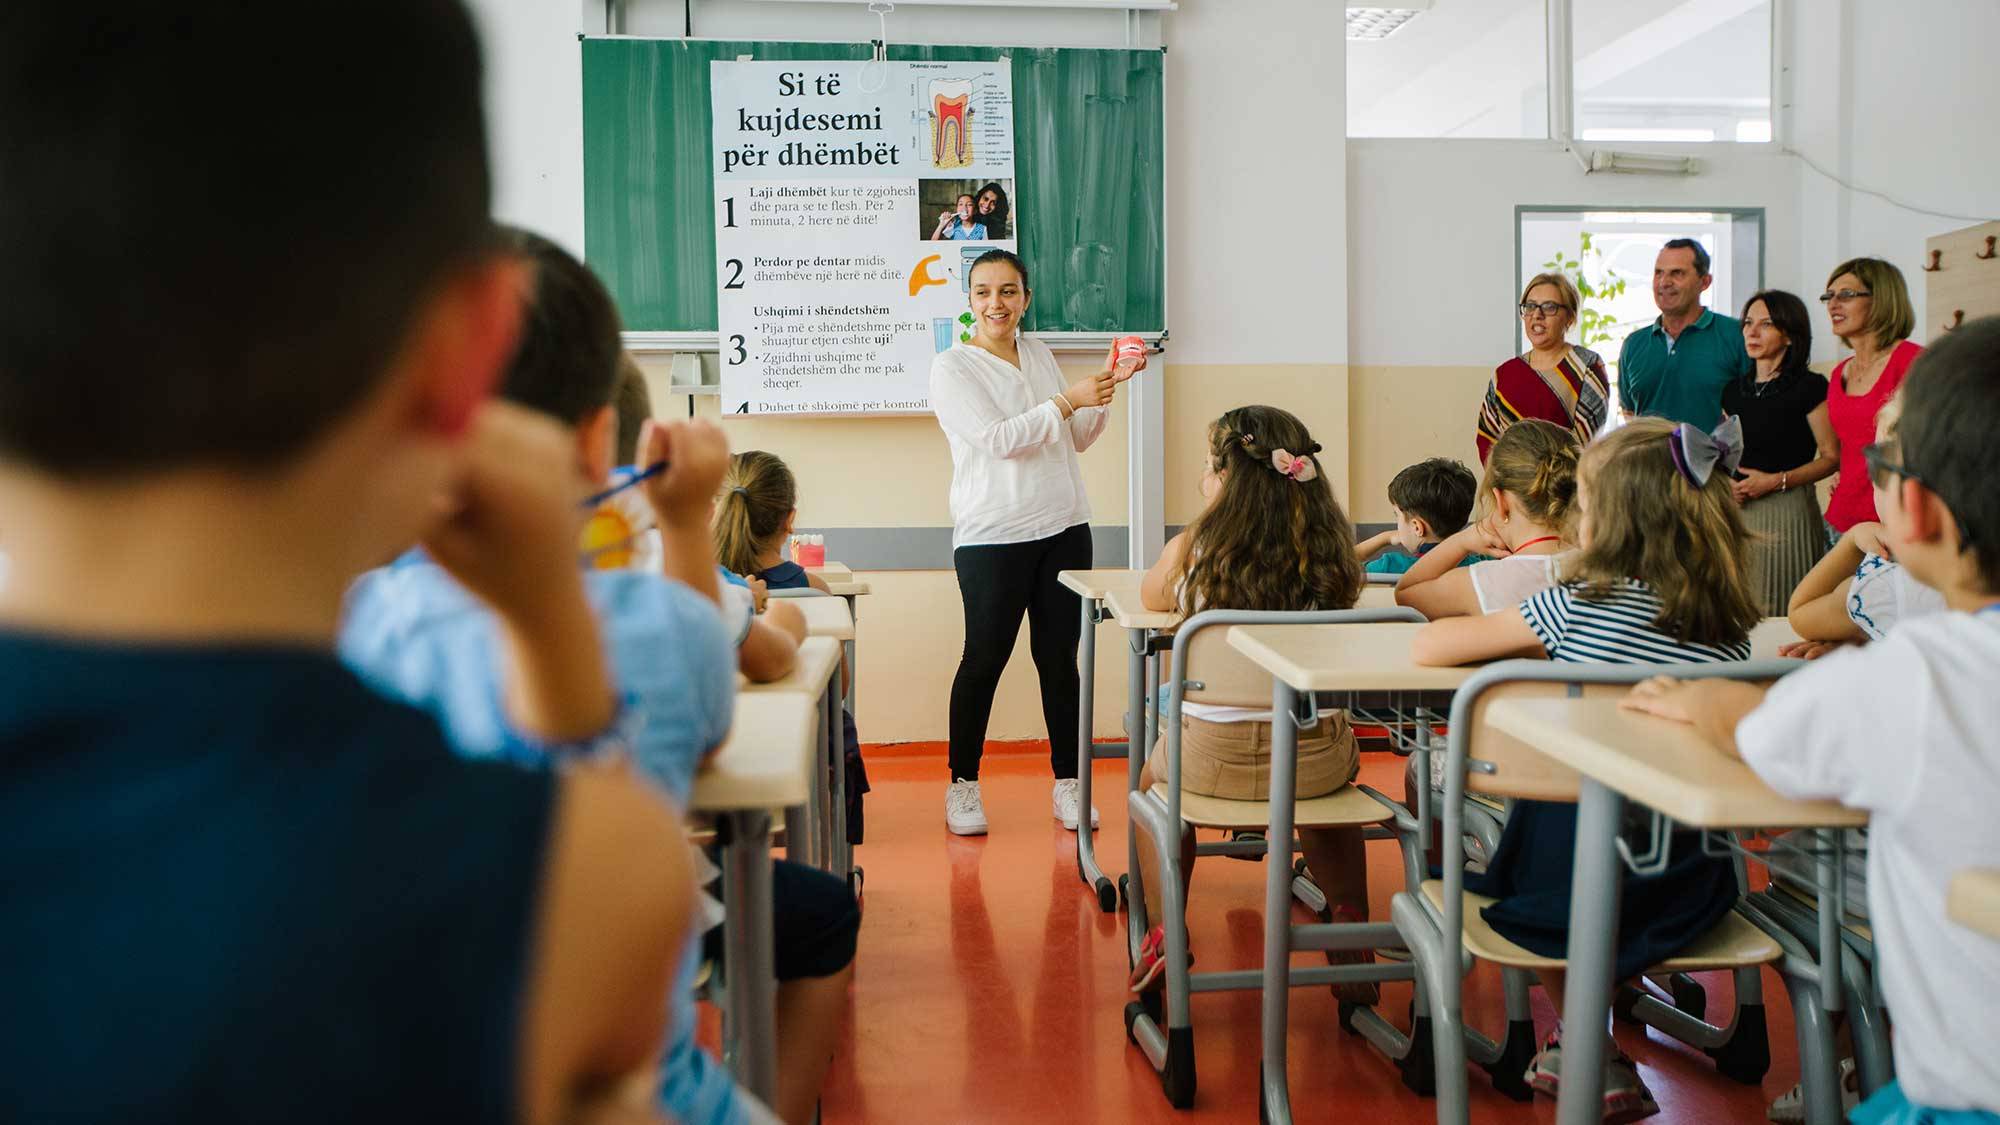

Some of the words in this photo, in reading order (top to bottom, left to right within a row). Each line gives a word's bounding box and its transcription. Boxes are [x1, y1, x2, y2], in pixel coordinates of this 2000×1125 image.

[779, 72, 805, 96] Si
[815, 73, 841, 96] të
[738, 107, 883, 136] kujdesemi
[723, 144, 769, 172] për
[778, 142, 900, 166] dhëmbët
[750, 186, 773, 199] Laji
[777, 185, 827, 198] dhëmbët
[831, 186, 850, 197] kur
[853, 187, 864, 196] të
[866, 185, 917, 199] zgjohesh
[722, 197, 739, 228] 1
[750, 201, 771, 212] dhe
[774, 202, 799, 214] para
[803, 203, 815, 211] se
[831, 200, 861, 211] flesh.
[865, 199, 884, 211] Për
[888, 200, 894, 210] 2
[751, 215, 795, 228] minuta,
[798, 215, 805, 226] 2
[836, 216, 850, 225] në
[853, 215, 878, 225] ditë!
[754, 256, 793, 267] Perdor
[797, 258, 810, 269] pe
[813, 255, 851, 266] dentar
[854, 255, 886, 266] midis
[724, 258, 745, 289] 2
[754, 270, 813, 282] dhëmbëve
[815, 270, 833, 283] një
[836, 270, 861, 280] herë
[863, 271, 877, 280] në
[880, 269, 905, 280] ditë.
[754, 305, 804, 318] Ushqimi
[807, 305, 811, 316] i
[814, 304, 890, 316] shëndetshëm
[762, 323, 784, 335] Pija
[787, 323, 805, 333] më
[817, 321, 892, 333] shëndetshme
[894, 322, 913, 335] për
[915, 321, 926, 331] ta
[762, 336, 809, 348] shuajtur
[874, 333, 894, 348] uji!
[728, 334, 747, 365] 3
[762, 352, 811, 365] Zgjidhni
[814, 352, 863, 365] ushqime
[866, 351, 877, 361] të
[763, 363, 836, 376] shëndetshëm
[839, 362, 861, 374] dhe
[864, 365, 882, 374] me
[884, 363, 905, 376] pak
[763, 378, 802, 391] sheqer.
[759, 402, 794, 412] Duhet
[797, 402, 809, 411] të
[811, 400, 860, 413] shkojmë
[862, 401, 880, 412] për
[883, 399, 929, 410] kontroll
